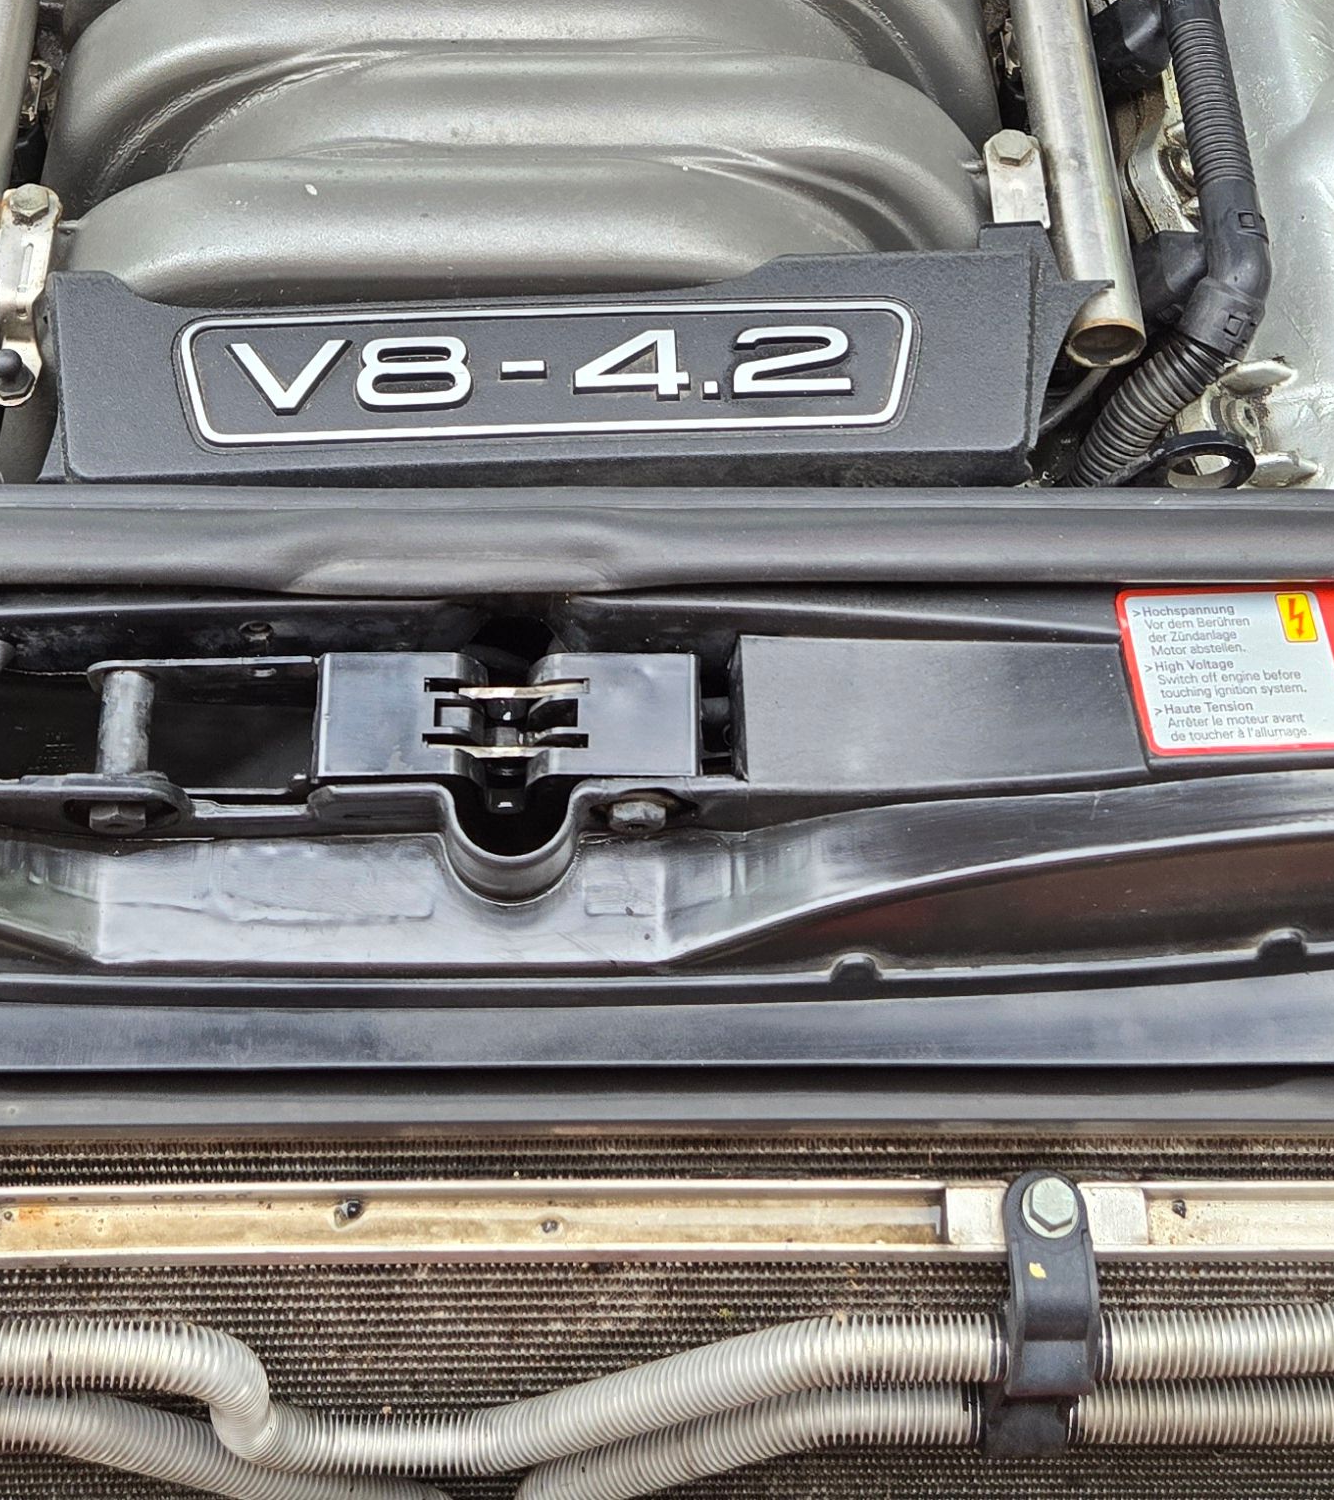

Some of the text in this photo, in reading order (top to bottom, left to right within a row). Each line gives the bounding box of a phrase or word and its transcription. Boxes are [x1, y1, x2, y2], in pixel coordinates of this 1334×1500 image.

[1143, 604, 1235, 618] Hochspannung
[1144, 616, 1250, 630] Vor dem Berühren
[1148, 629, 1237, 643] der Zündanlage
[1151, 642, 1247, 656] Motor abstellen.
[1155, 659, 1234, 674] High Voltage
[1158, 669, 1301, 685] Switch off engine before
[1160, 684, 1307, 699] touching ignition system.
[1164, 700, 1253, 715] Haute Tension
[1168, 713, 1305, 729] Arrêter le moteur avant
[1171, 731, 1186, 742] de
[1190, 729, 1234, 741] toucher
[1237, 728, 1245, 739] à
